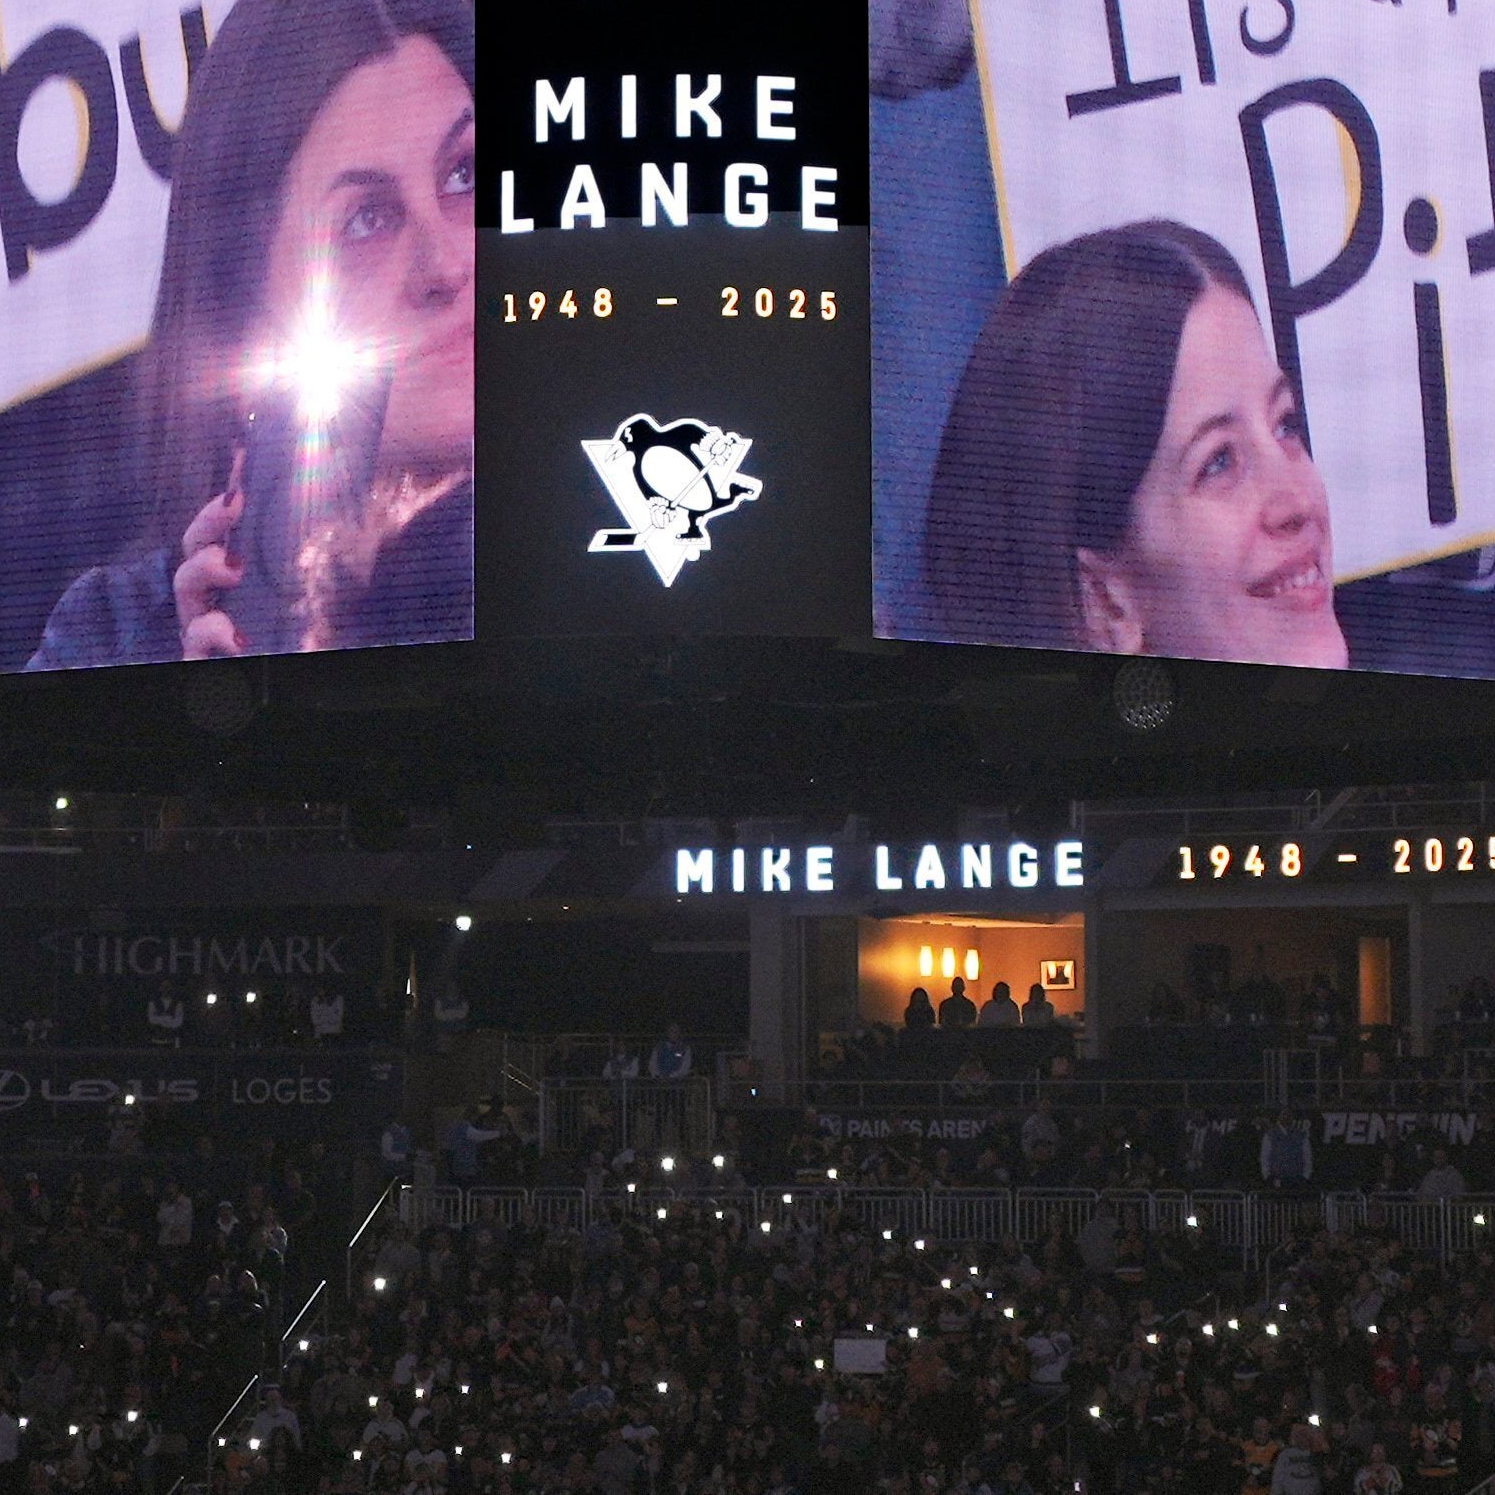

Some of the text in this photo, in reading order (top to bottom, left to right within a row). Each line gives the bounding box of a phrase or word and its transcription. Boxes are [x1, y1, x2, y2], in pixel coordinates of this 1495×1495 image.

[535, 73, 796, 143] MIKE
[501, 162, 839, 234] LANGE
[504, 287, 613, 323] 1948
[721, 286, 837, 322] 2025
[675, 845, 835, 894] MIKE
[875, 839, 1084, 891] LANGE
[1178, 841, 1303, 880] 1948
[72, 935, 345, 976] HIGHMARK
[41, 1077, 333, 1106] LEXUS LOGES
